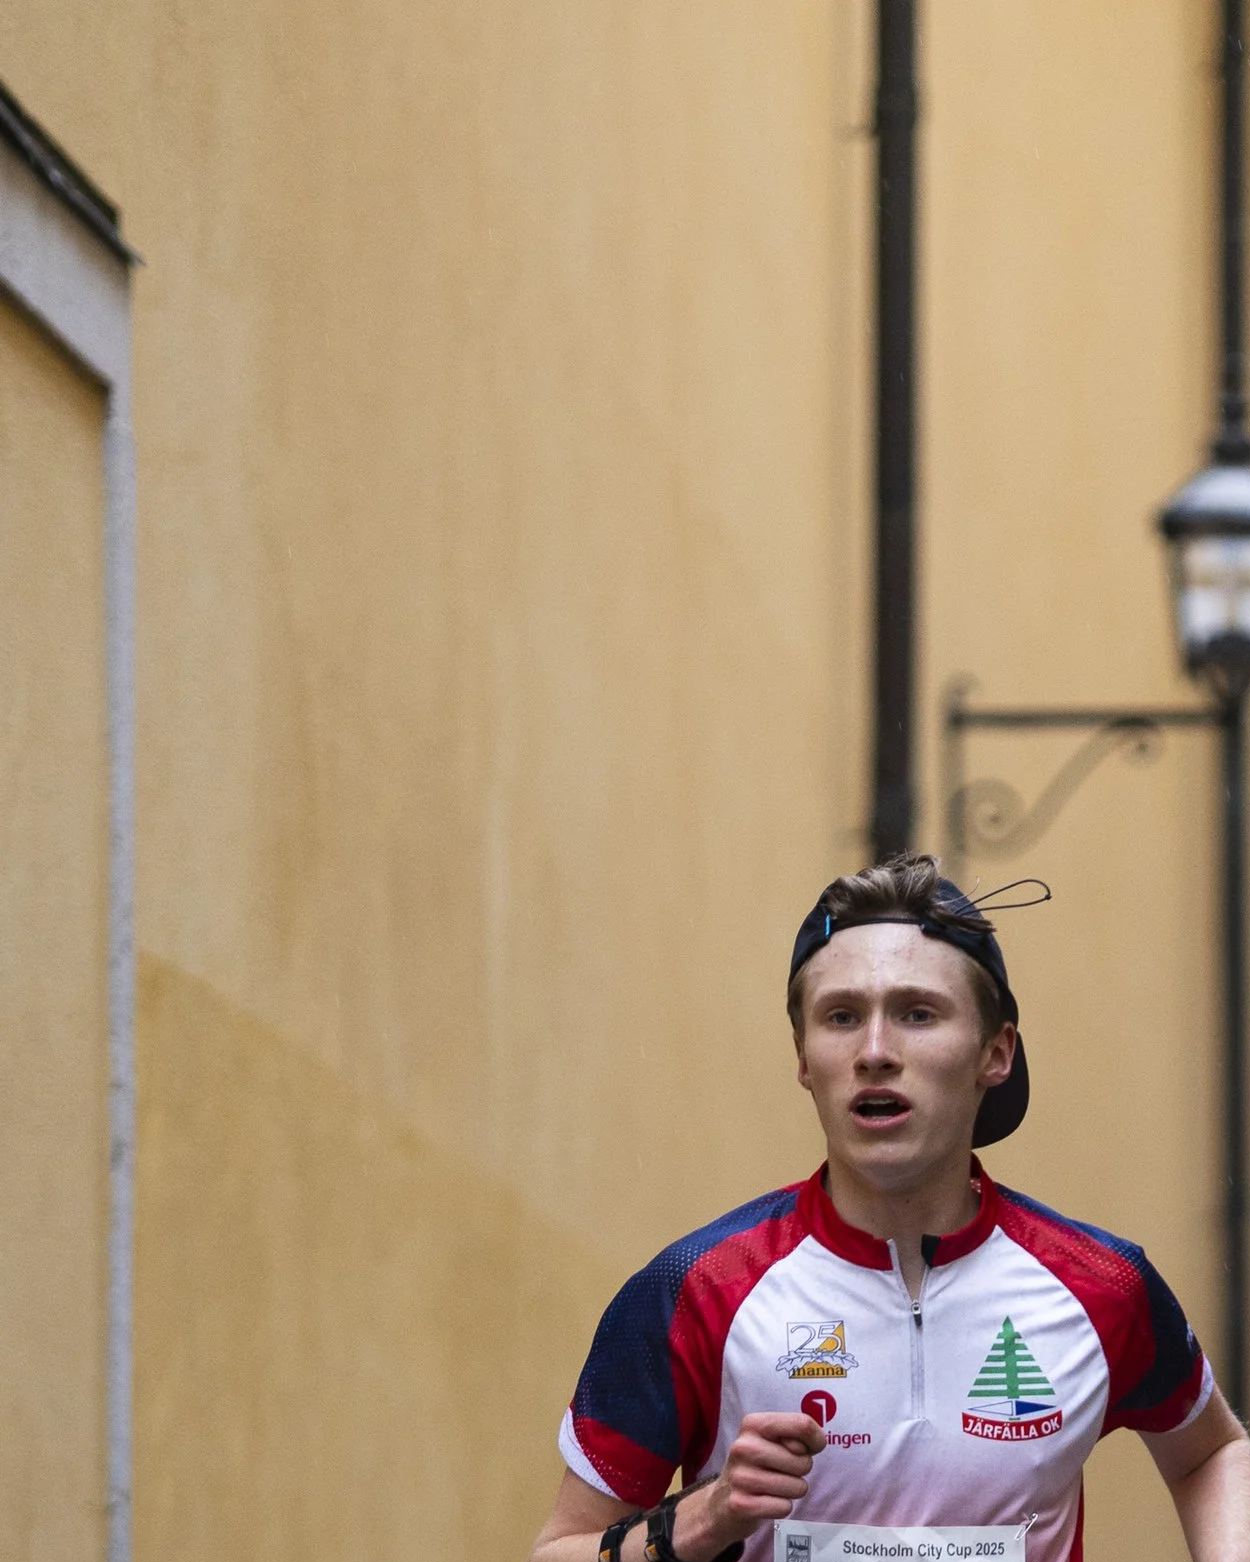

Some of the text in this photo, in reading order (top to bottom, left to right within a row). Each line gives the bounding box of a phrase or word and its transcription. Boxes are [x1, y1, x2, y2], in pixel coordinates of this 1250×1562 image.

[790, 1324, 842, 1354] 25
[792, 1366, 844, 1377] manna
[965, 1416, 1061, 1440] JÄRFÄLLA OK
[843, 1540, 1005, 1560] Stockholm City Cup 2025
